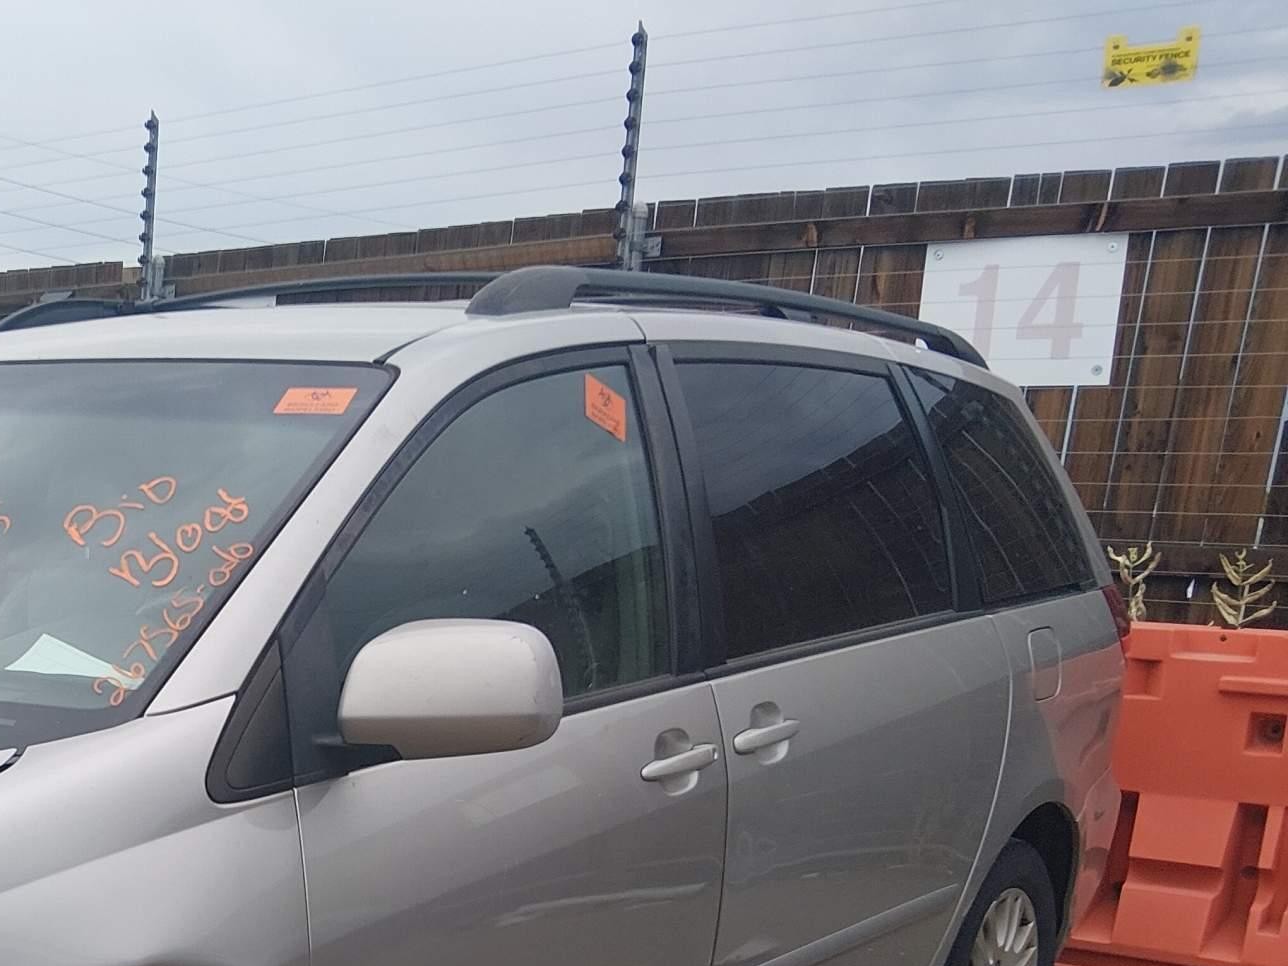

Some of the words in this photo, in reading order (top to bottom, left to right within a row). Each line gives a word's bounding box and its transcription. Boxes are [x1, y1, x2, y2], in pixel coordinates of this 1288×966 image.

[1111, 54, 1158, 66] SECURITY
[1158, 50, 1191, 61] FENCE
[958, 261, 1085, 363] 14
